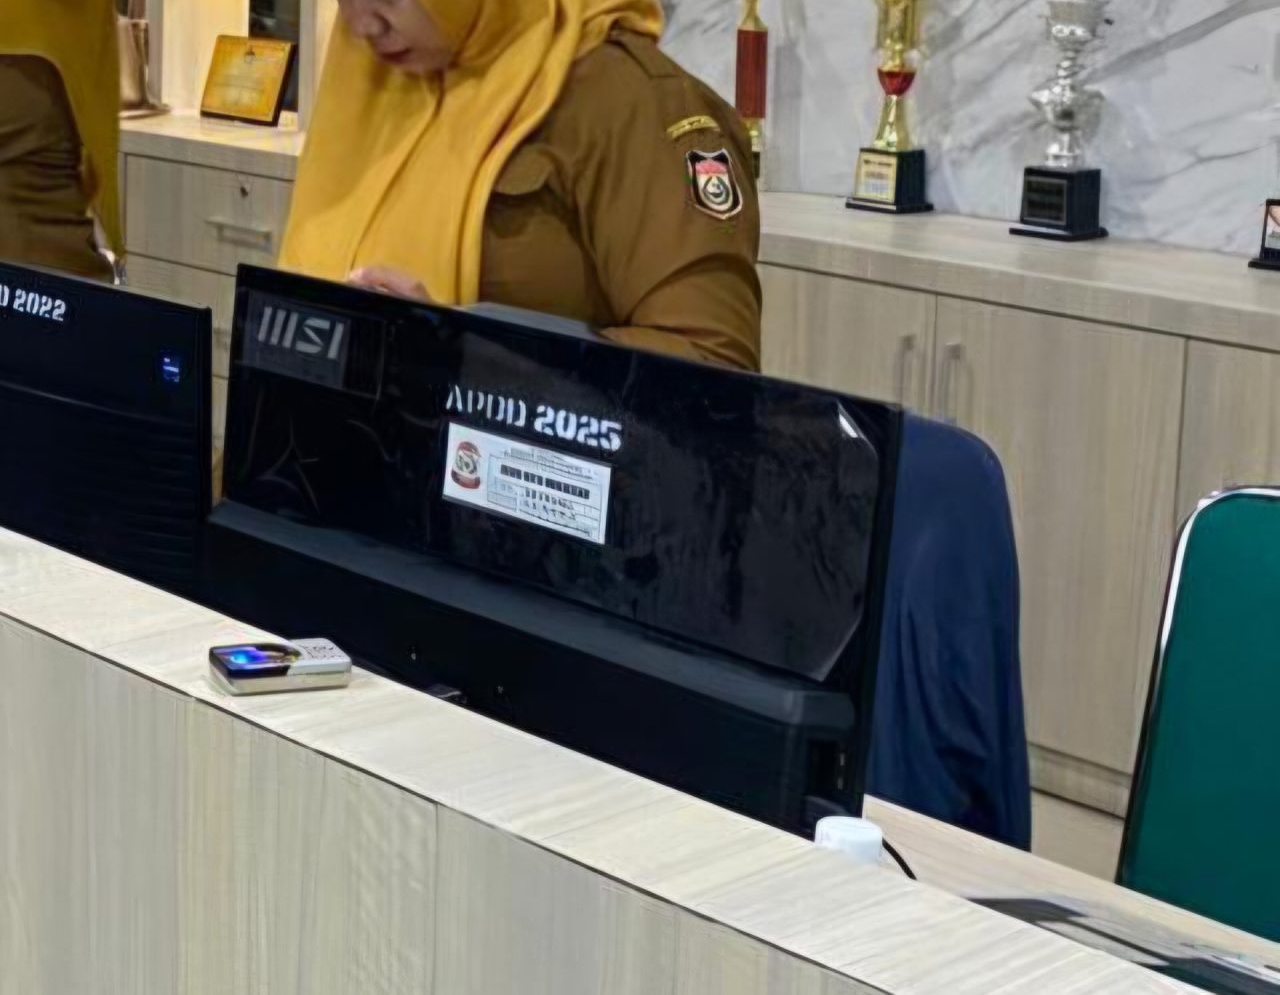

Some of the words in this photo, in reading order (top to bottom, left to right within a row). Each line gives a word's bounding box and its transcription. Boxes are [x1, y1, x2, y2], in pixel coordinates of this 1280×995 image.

[13, 289, 66, 322] 2022
[258, 306, 345, 360] MSI
[534, 405, 621, 452] 2025
